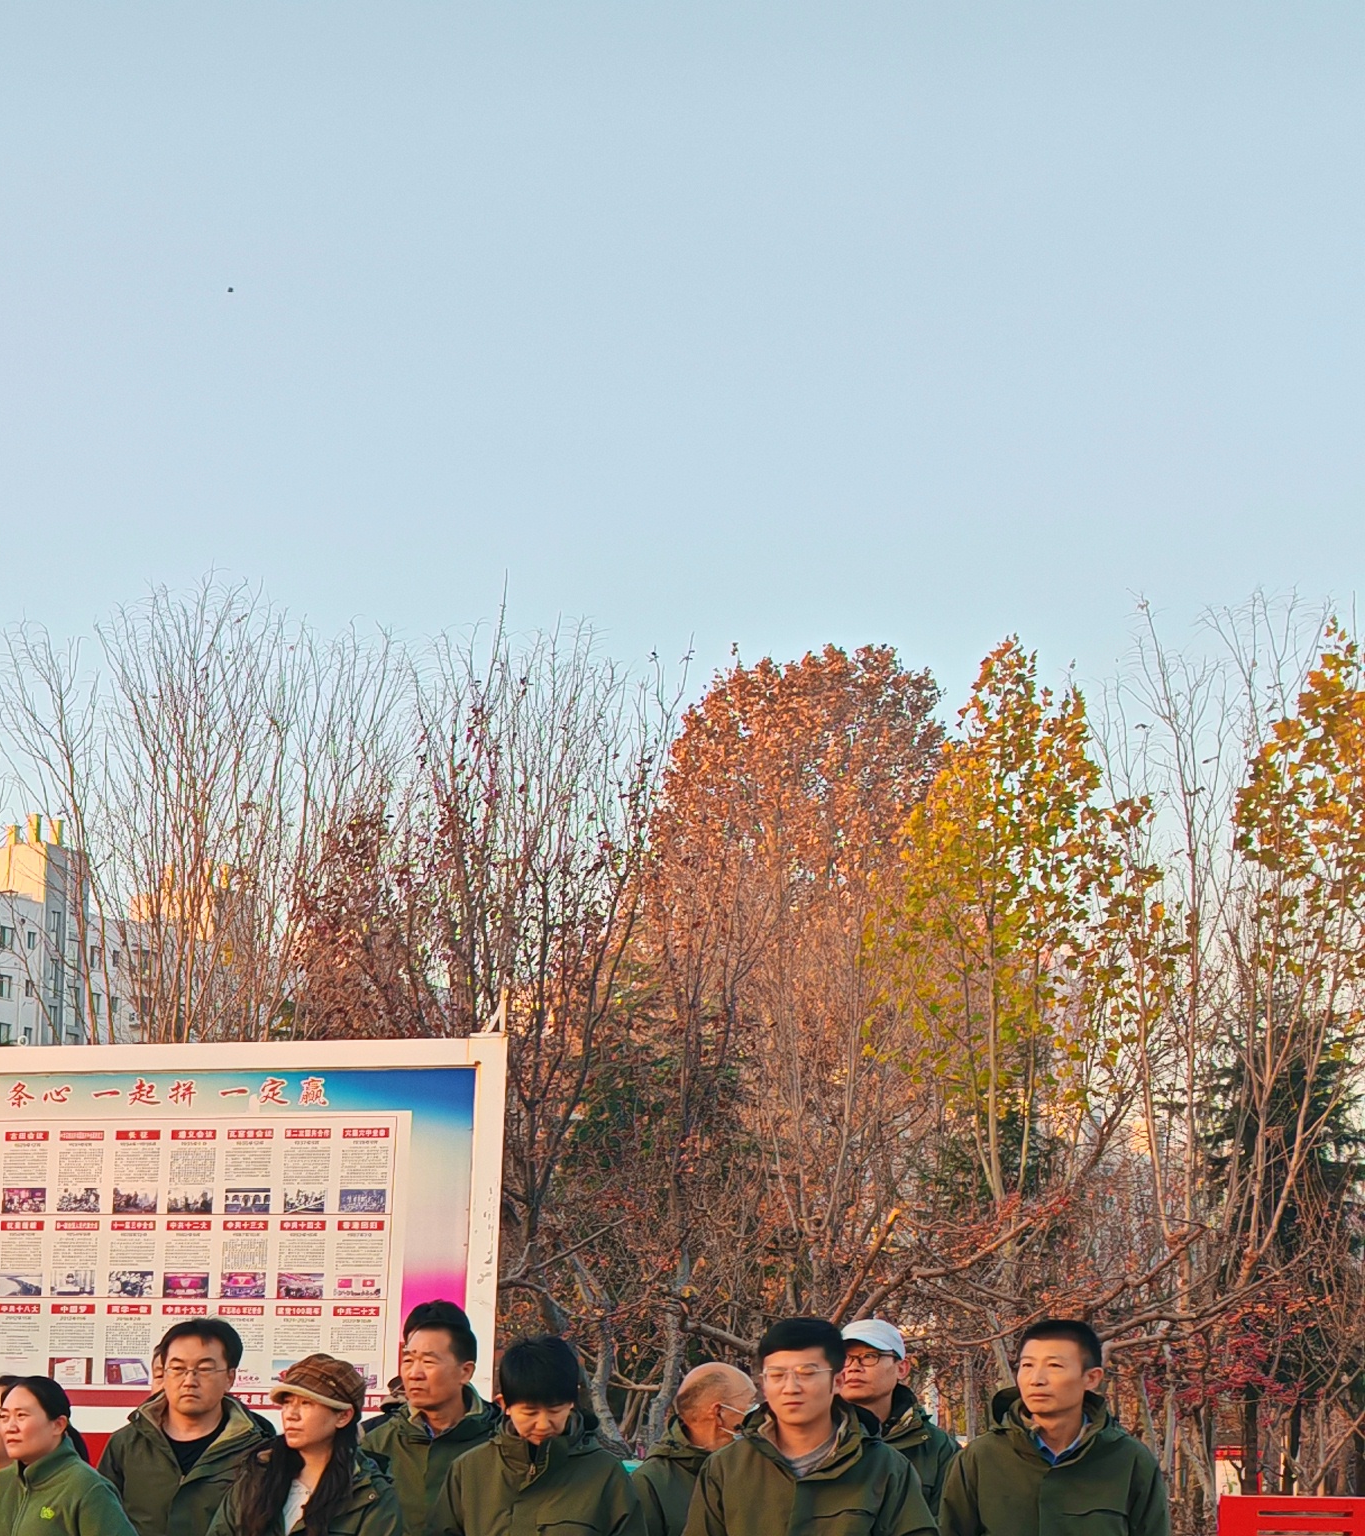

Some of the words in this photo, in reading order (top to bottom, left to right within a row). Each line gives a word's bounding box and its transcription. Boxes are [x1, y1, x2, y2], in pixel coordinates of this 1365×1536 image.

[92, 1078, 198, 1109] 一起拼
[218, 1077, 330, 1107] 一定赢
